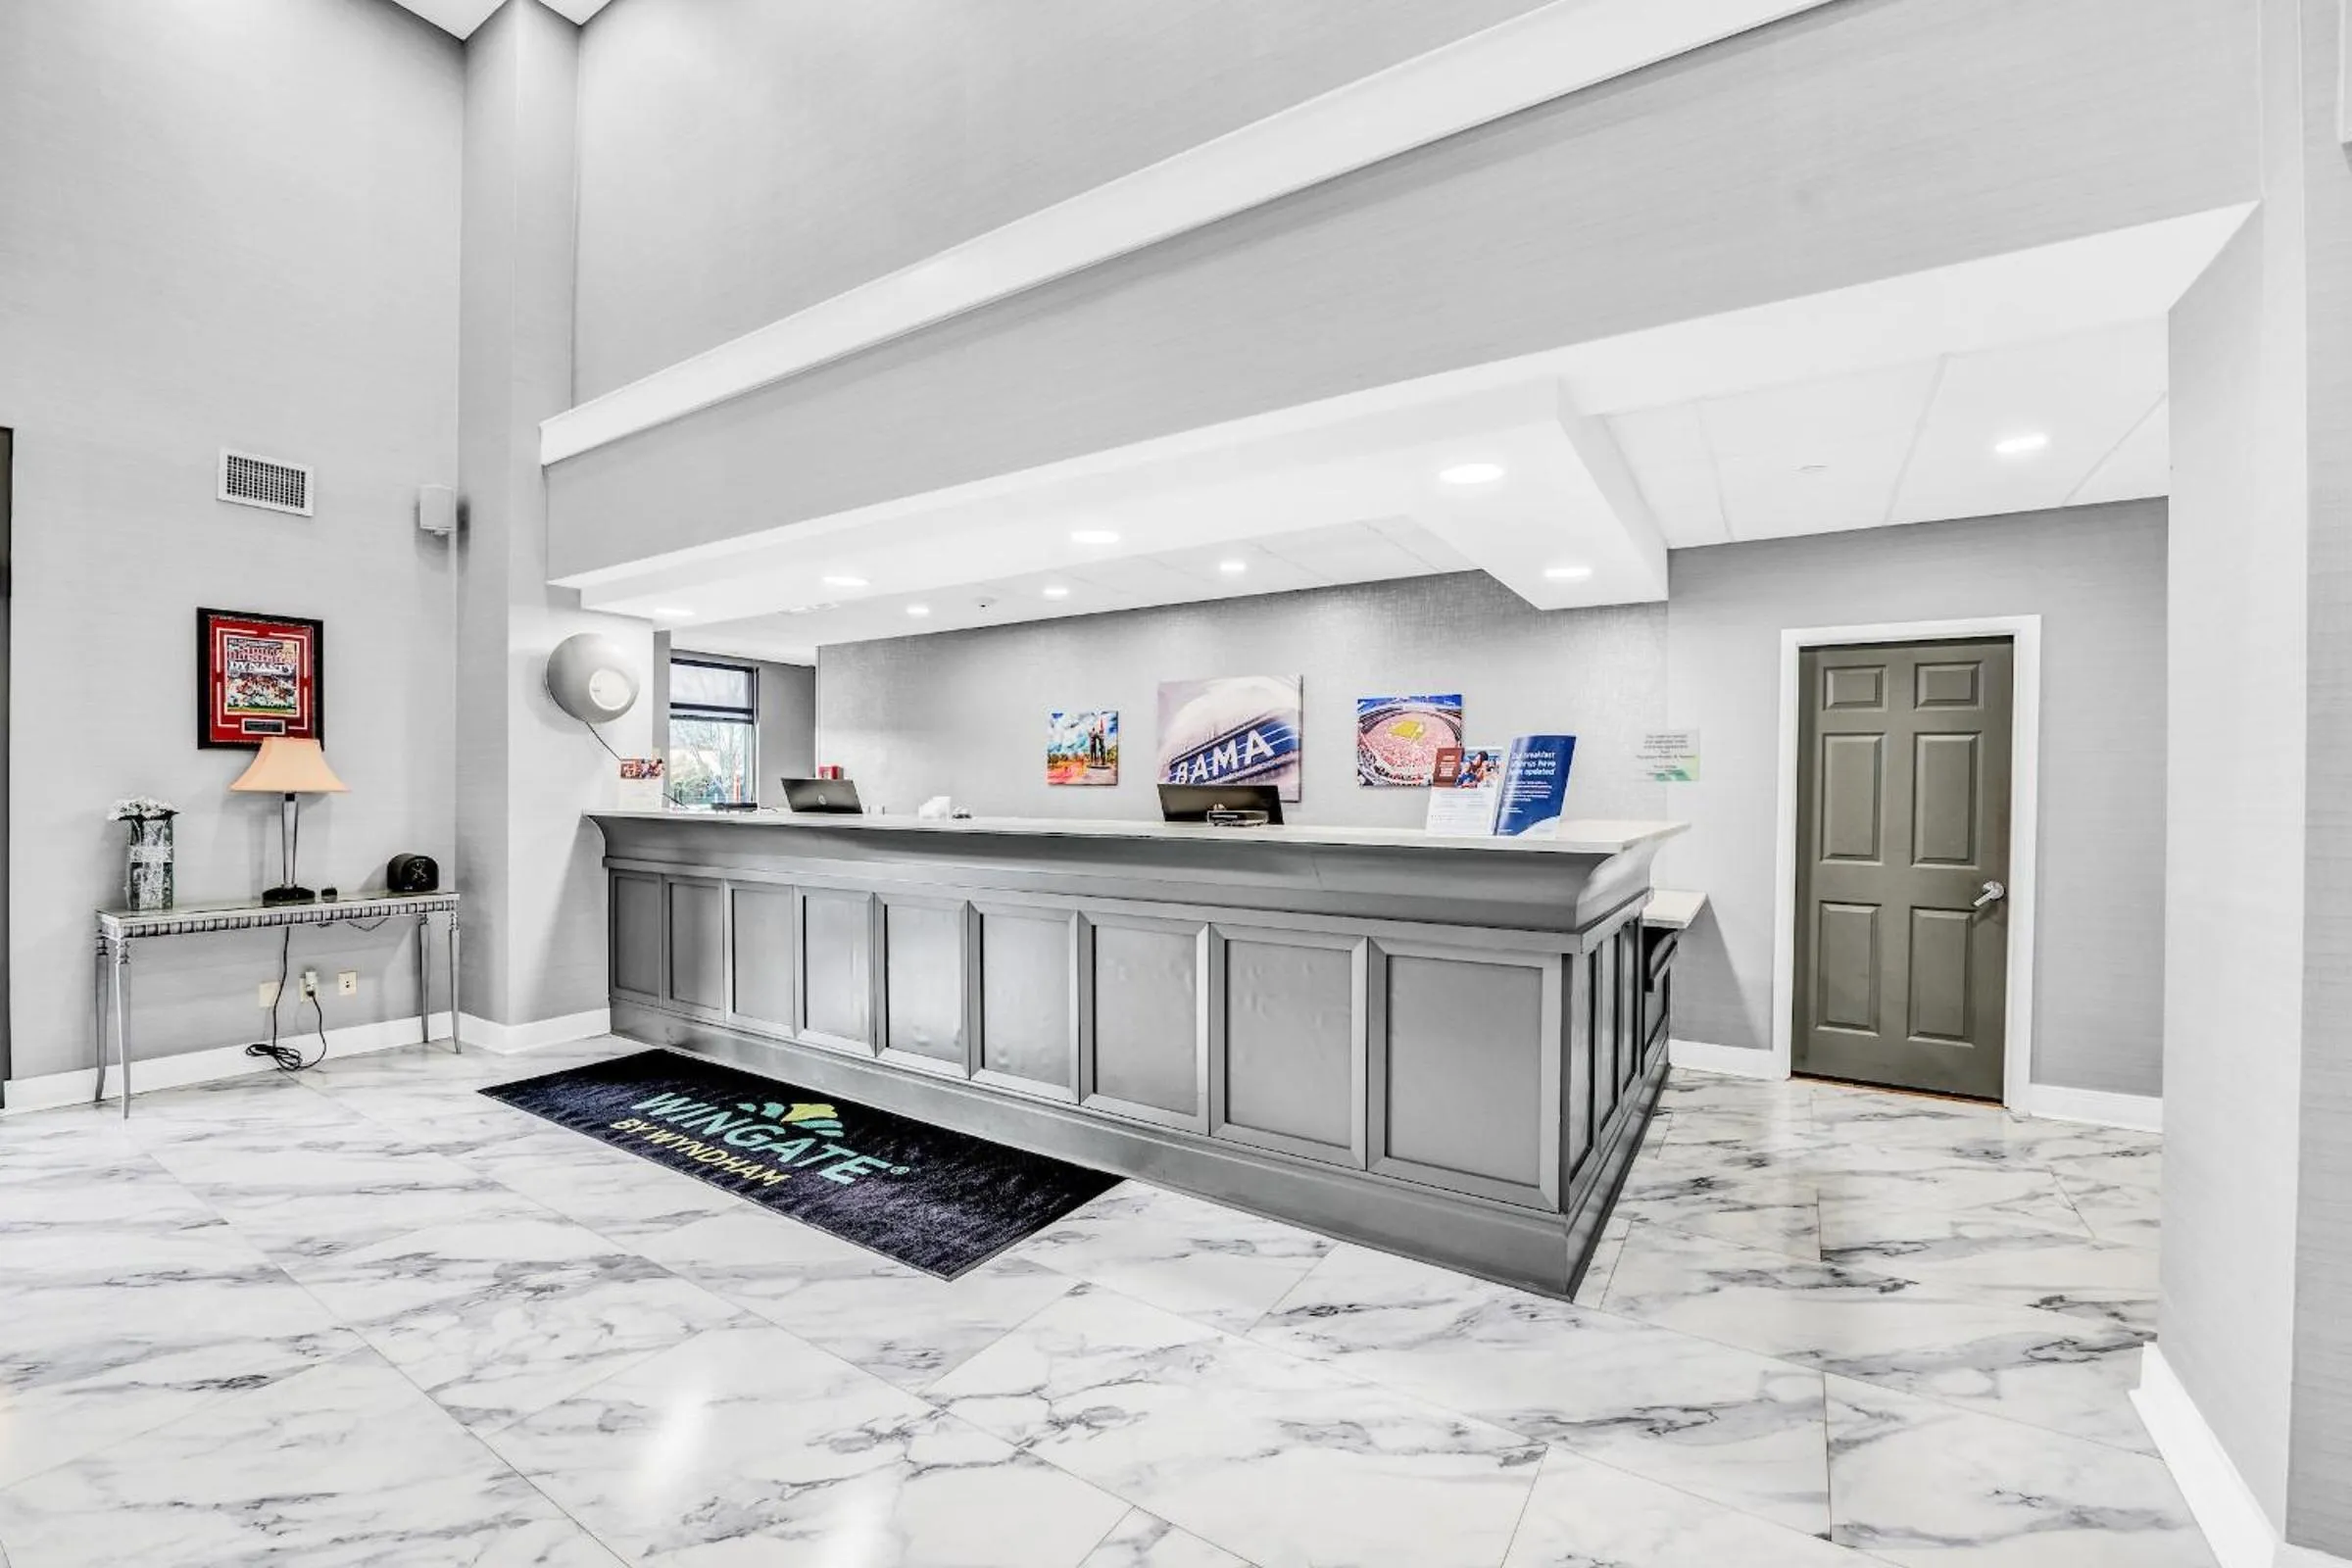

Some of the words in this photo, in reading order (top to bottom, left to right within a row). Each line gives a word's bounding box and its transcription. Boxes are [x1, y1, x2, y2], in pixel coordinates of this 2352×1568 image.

[1173, 728, 1275, 785] BAMA
[610, 1117, 652, 1134] BY
[644, 1128, 793, 1187] WYNDHAM
[631, 1092, 894, 1185] WINGATE
